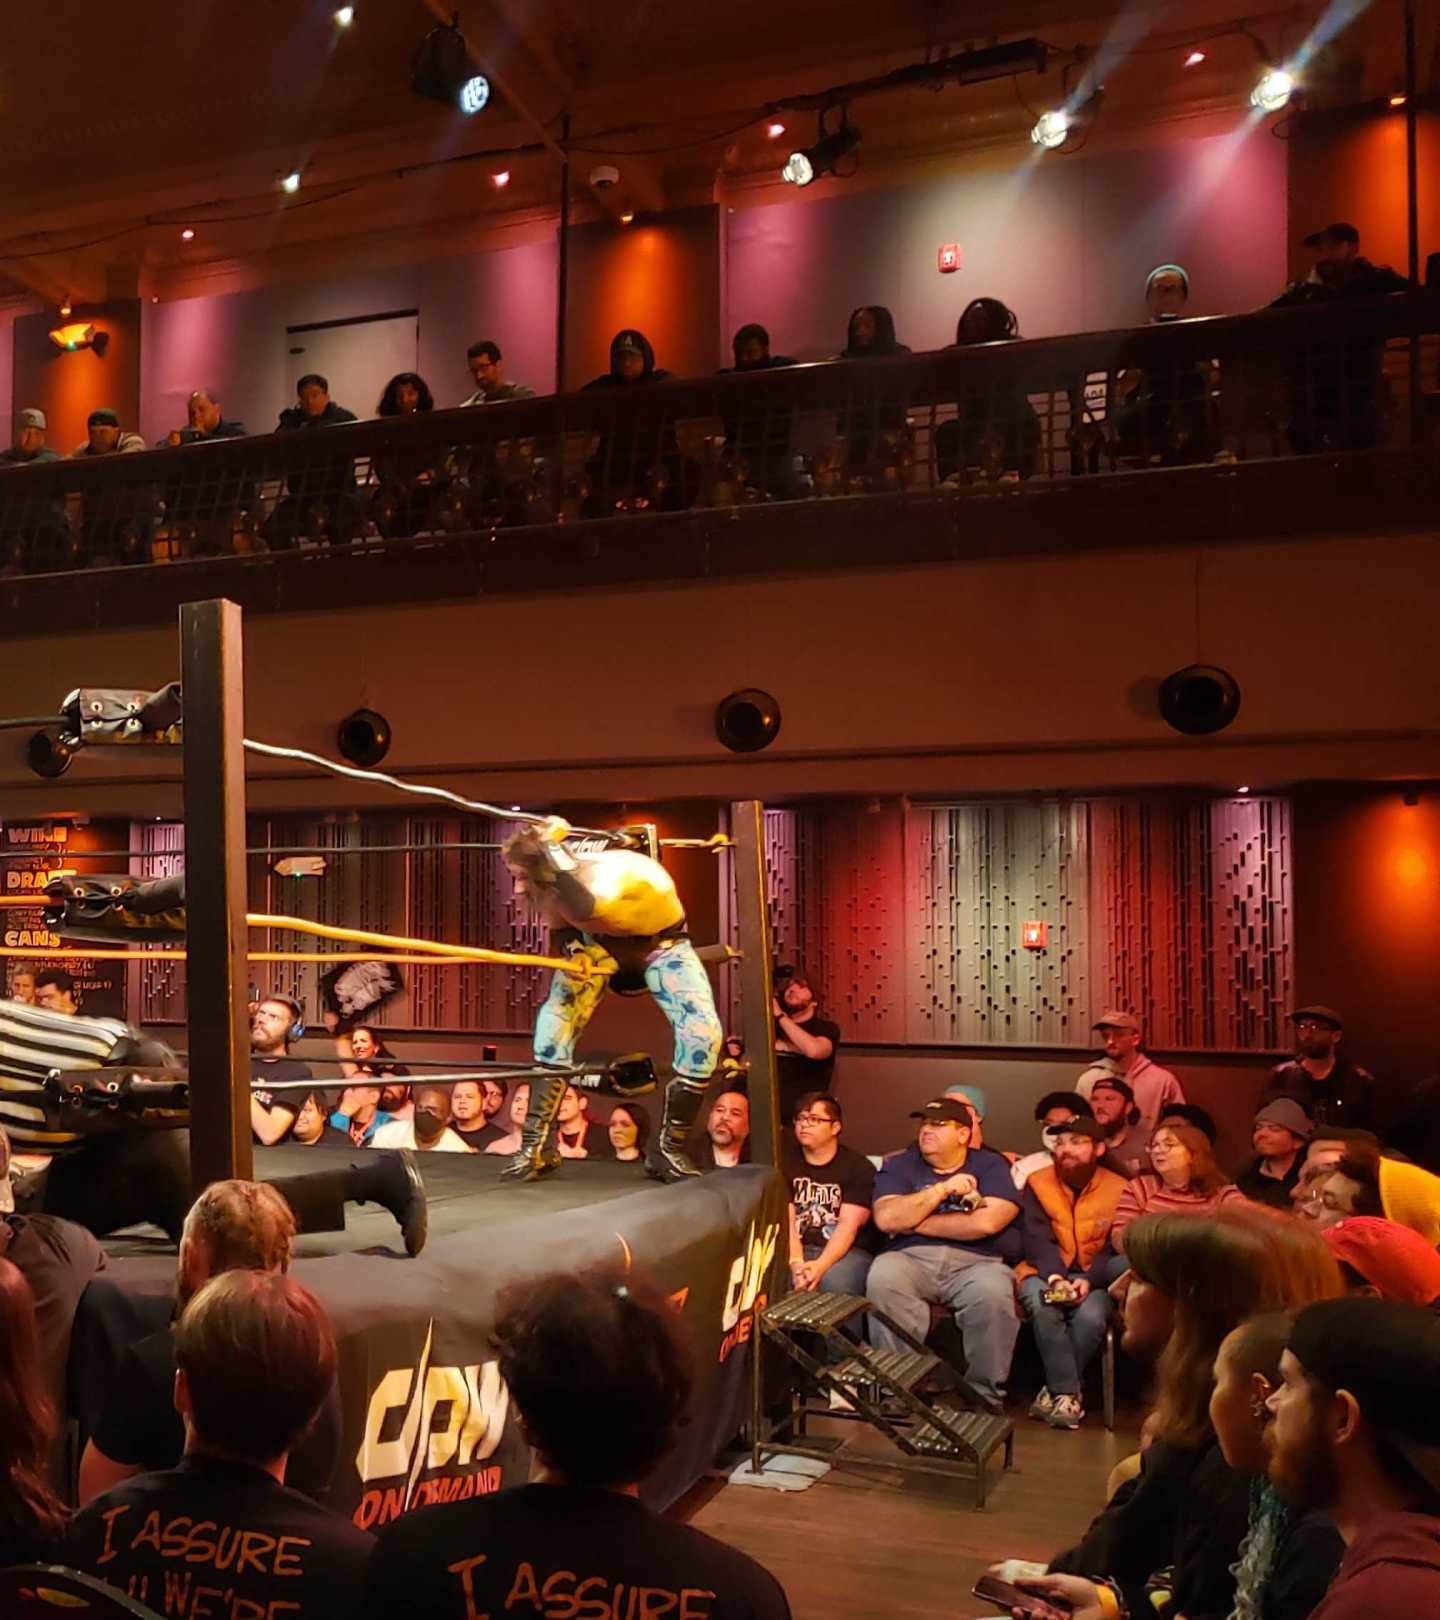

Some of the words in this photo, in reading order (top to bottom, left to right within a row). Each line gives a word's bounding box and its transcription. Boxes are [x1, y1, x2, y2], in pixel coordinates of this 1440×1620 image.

[6, 870, 77, 889] DRA
[4, 930, 61, 947] CANS
[353, 1486, 406, 1531] ON
[95, 1504, 132, 1565] I
[130, 1510, 312, 1577] ASSURE
[447, 1554, 490, 1620] I
[504, 1562, 716, 1620] ASSURE
